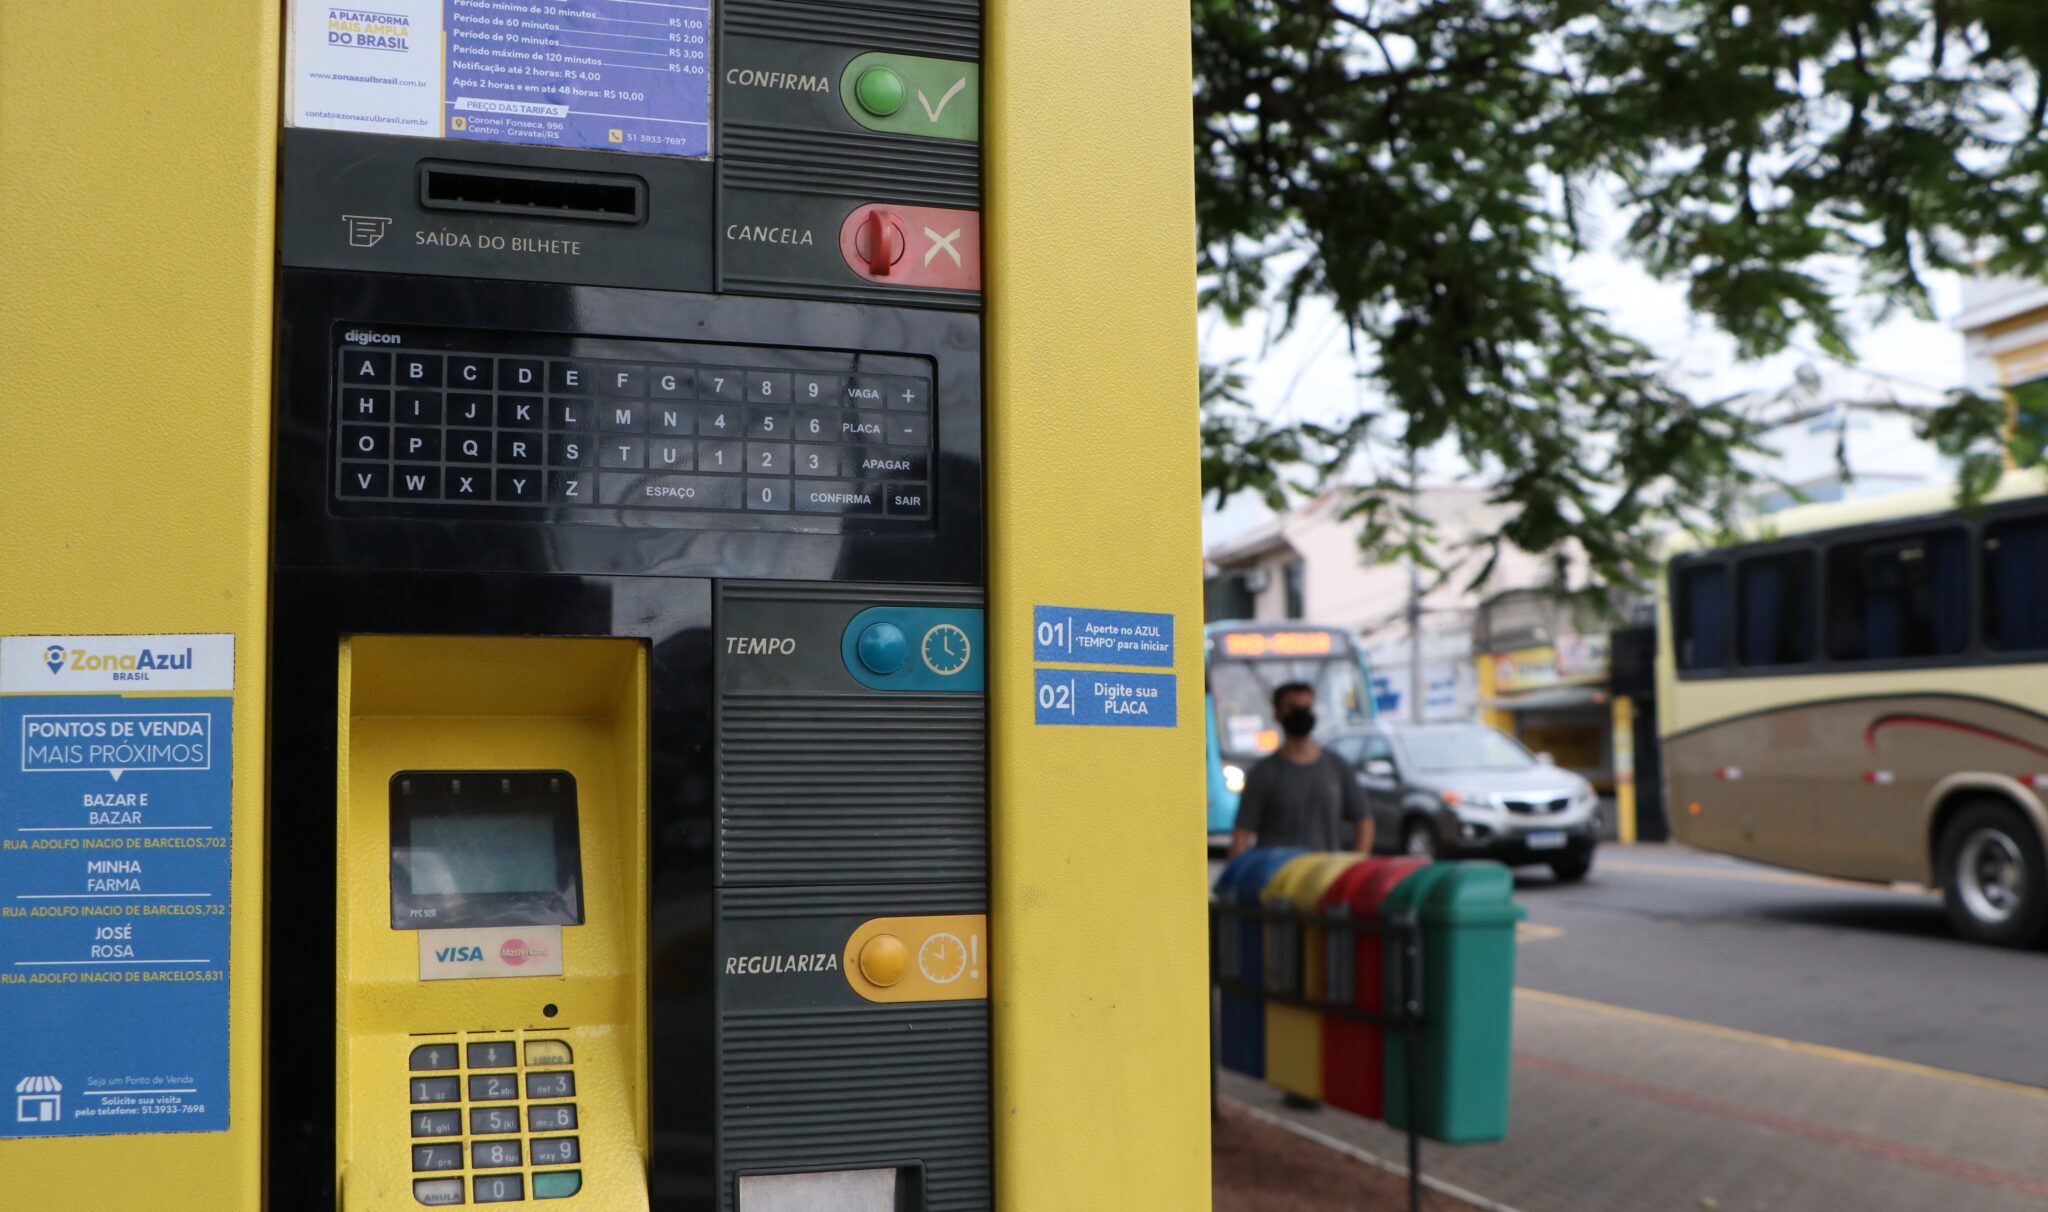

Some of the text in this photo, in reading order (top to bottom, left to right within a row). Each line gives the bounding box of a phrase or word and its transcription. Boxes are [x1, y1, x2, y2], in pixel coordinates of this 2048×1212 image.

[329, 11, 410, 26] A PLATAFORMA
[530, 4, 596, 18] de 30 minutos
[328, 20, 409, 36] MAIS AMPLA
[454, 13, 560, 31] Período de 60 minutos
[669, 18, 702, 29] R$ 1,00
[328, 31, 409, 50] DO BRASIL
[454, 28, 560, 46] Período de 90 minutos
[669, 33, 704, 44] R$ 2,00
[453, 44, 602, 66] Período máximo de 120 minutos
[669, 48, 704, 60] R$ 3,00
[453, 60, 600, 81] Notificação até 2 horas: R$ 4,00
[669, 64, 704, 74] R$ 4,00
[309, 72, 427, 87] www.zonaazulbrasil.com.br
[726, 68, 830, 93] CONFIRMA
[453, 77, 478, 88] Após
[480, 79, 486, 88] 2
[488, 80, 515, 90] horas
[524, 85, 539, 93] em
[542, 84, 556, 94] até
[558, 86, 571, 95] 48
[572, 87, 602, 98] horas:
[604, 90, 616, 100] R$
[618, 91, 644, 102] 10,00
[466, 100, 559, 116] PREÇO DAS TARIFAS
[305, 110, 428, 126] contato@zonaazulbrasil.com.br
[546, 122, 564, 130] 996
[640, 134, 686, 146] 3933-7697
[415, 227, 582, 256] SAÍDA DO BILHETE
[726, 224, 814, 246] CANCELA
[345, 330, 401, 345] digicon
[360, 360, 880, 400] A B C D E F G 7 8 9 VAGA
[360, 398, 880, 434] H I J K L M N 4 5 6 PLACA
[358, 436, 910, 470] O P Q R S T U 1 2 3 APAGAR
[358, 474, 920, 506] V W X Y Z ESPAÇO 0 CONFIRMA SAIR
[1037, 622, 1064, 646] 01
[1086, 622, 1160, 637] Aperte no AZUL
[725, 636, 796, 656] TEMPO
[1118, 641, 1139, 652] para
[1141, 640, 1169, 652] iniciar
[70, 648, 192, 670] ZonaAzul
[1038, 684, 1070, 709] 02
[1094, 682, 1158, 700] Digite sua
[1104, 700, 1148, 714] PLACA
[28, 720, 204, 738] PONTOS DE VENDA
[28, 740, 204, 764] MAIS PRÓXIMOS
[84, 794, 148, 806] BAZAR E
[89, 812, 142, 824] BAZAR
[4, 837, 226, 850] RUA ADOLFO INACIO DE BARCELOS,702
[88, 860, 142, 874] MINHA
[88, 878, 141, 892] FARMA
[95, 923, 132, 940] JOSÉ
[91, 945, 134, 958] ROSA
[435, 946, 484, 962] VISA
[725, 954, 838, 974] REGULARIZA
[420, 1076, 566, 1100] 1 2 3
[102, 1096, 136, 1106] Solicite
[156, 1096, 182, 1104] visita
[75, 1104, 205, 1118] pelo telefone: 51.3933-7698
[420, 1108, 569, 1133] 4 5 6
[422, 1142, 572, 1167] 7 8 9
[493, 1181, 504, 1198] 0
